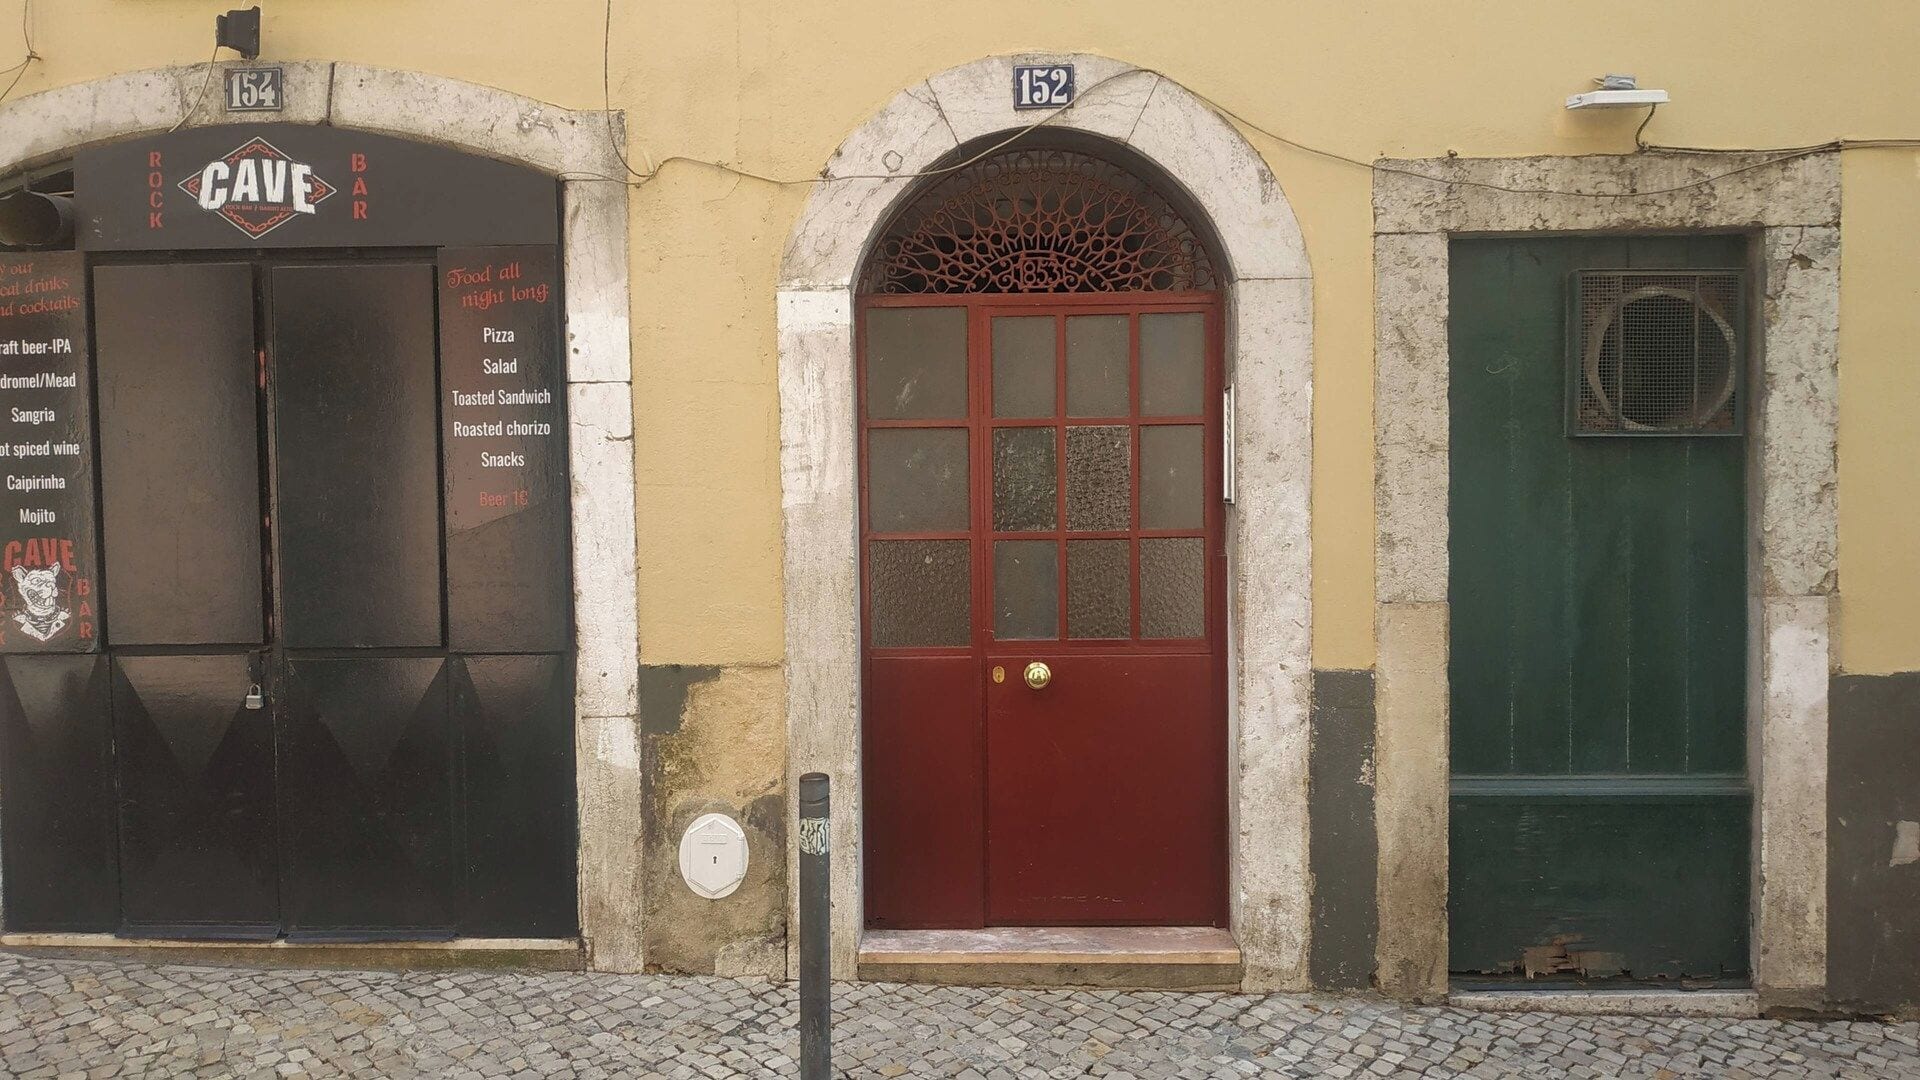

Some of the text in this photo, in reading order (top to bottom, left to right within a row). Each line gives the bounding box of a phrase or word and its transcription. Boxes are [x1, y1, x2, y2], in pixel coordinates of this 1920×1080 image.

[231, 72, 276, 107] 154
[1020, 69, 1068, 105] 152
[148, 151, 163, 228] ROCK
[198, 158, 317, 215] CAVE
[351, 152, 368, 220] BAR
[25, 275, 70, 294] drinks
[447, 262, 522, 289] Food all
[20, 296, 80, 315] cocktails
[462, 283, 549, 310] night long
[483, 327, 515, 343] Pizza
[22, 337, 72, 355] beer-IPA
[483, 358, 518, 375] Salad
[452, 389, 551, 406] Toasted Sandwich
[11, 407, 55, 425] Sangria
[453, 420, 551, 437] Roasted chorizo
[13, 440, 49, 460] spiced
[53, 441, 80, 456] wine
[481, 451, 525, 468] Snacks
[7, 474, 66, 493] Caipirinha
[480, 491, 508, 507] Beer
[20, 508, 56, 526] Mojito
[4, 537, 77, 572] CAVE
[77, 578, 93, 639] BAR
